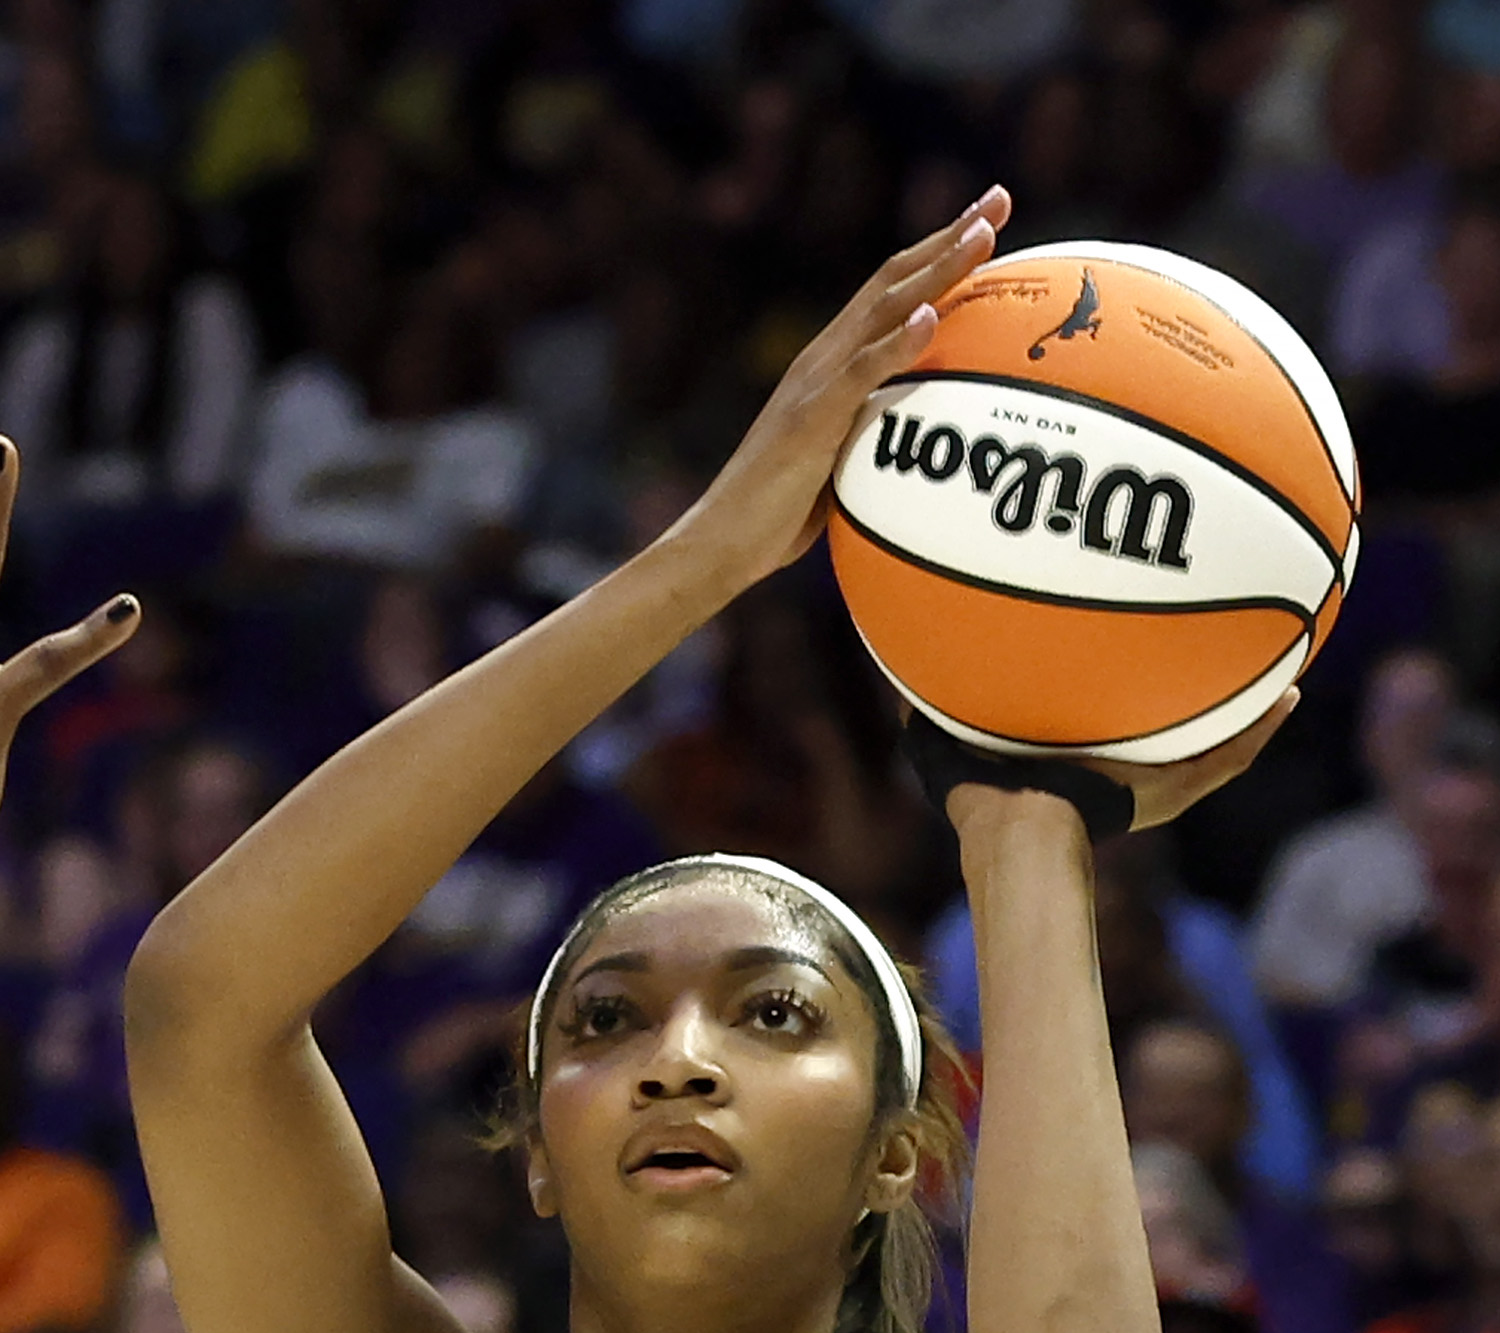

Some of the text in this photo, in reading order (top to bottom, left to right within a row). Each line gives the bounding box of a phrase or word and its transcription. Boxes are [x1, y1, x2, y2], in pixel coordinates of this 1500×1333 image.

[990, 406, 1078, 436] EVO NXT
[873, 408, 1196, 573] Wilson
